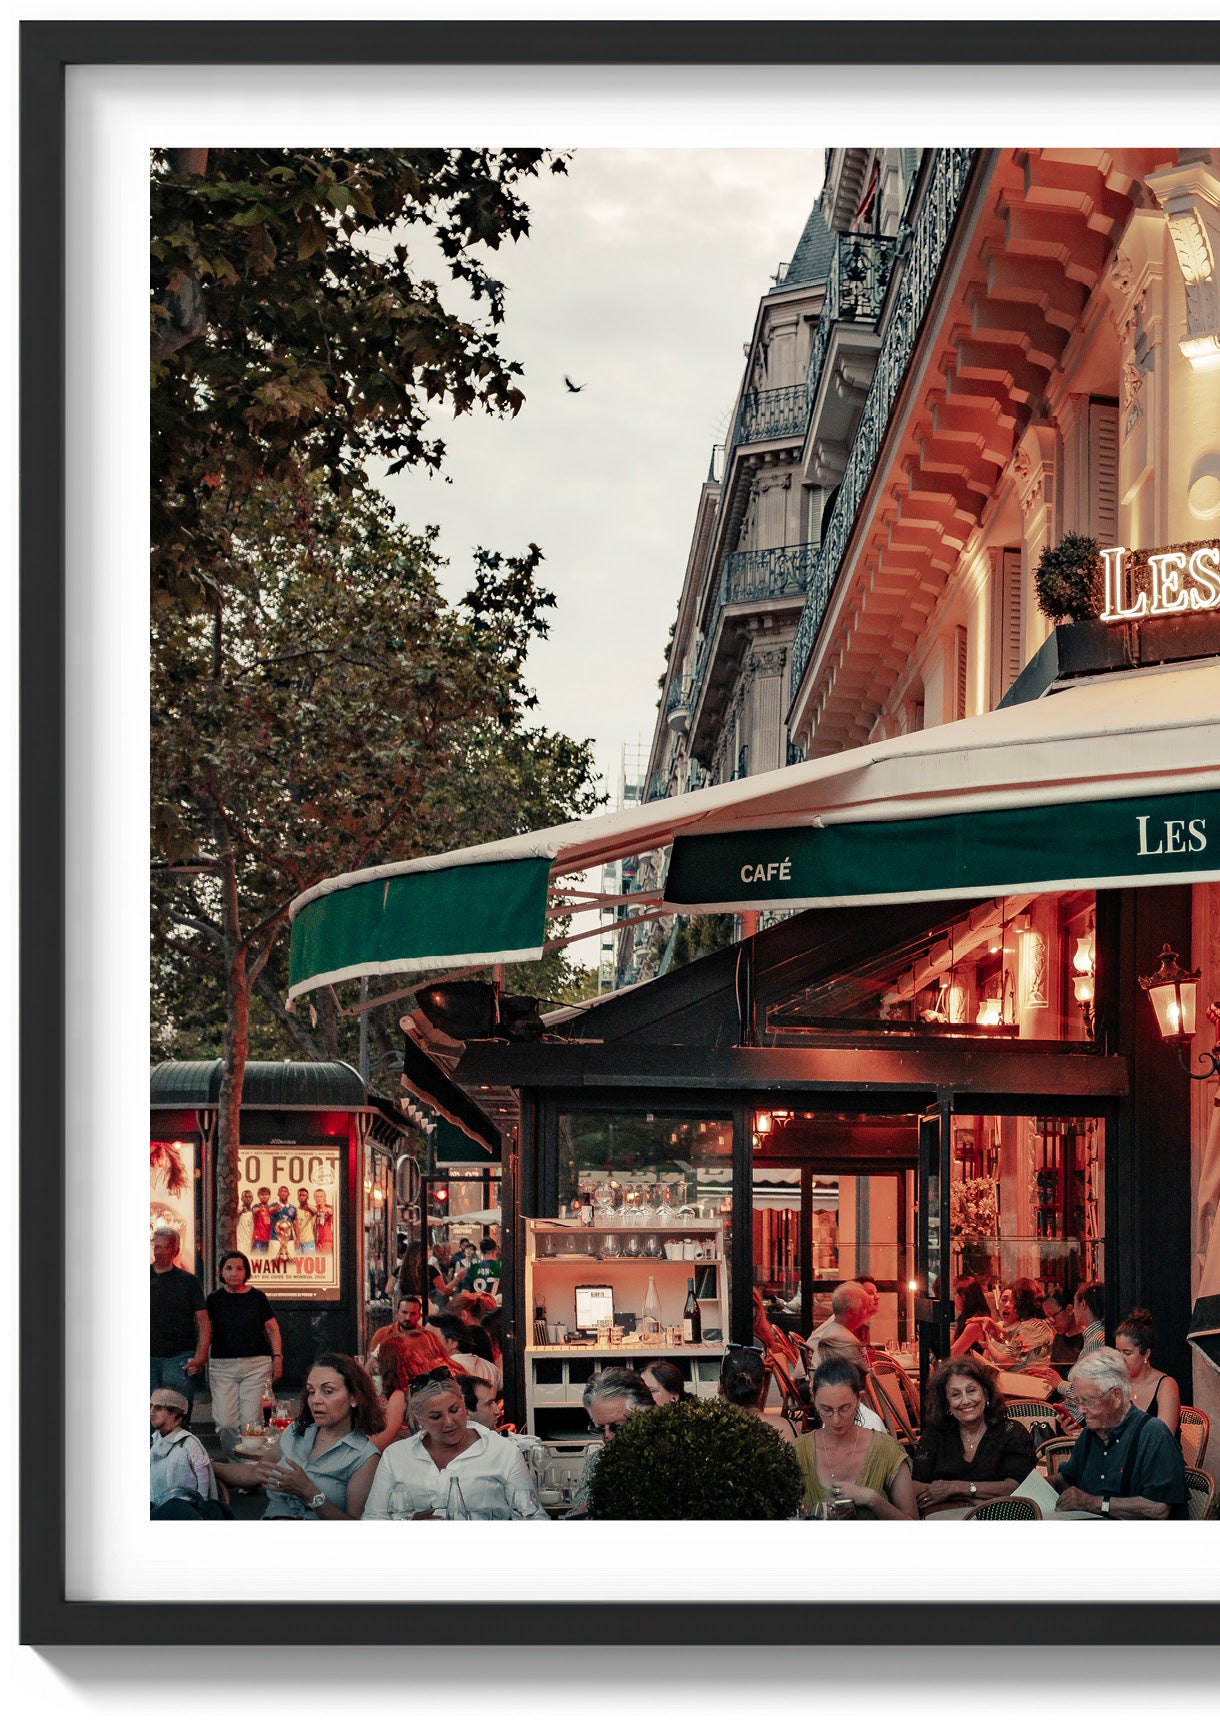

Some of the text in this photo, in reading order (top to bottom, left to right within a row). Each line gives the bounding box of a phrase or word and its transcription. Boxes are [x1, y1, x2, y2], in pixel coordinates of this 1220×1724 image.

[1136, 815, 1207, 856] LES
[740, 856, 792, 883] CAFÉ
[238, 1155, 260, 1184] O
[251, 1257, 326, 1275] WANT YOU
